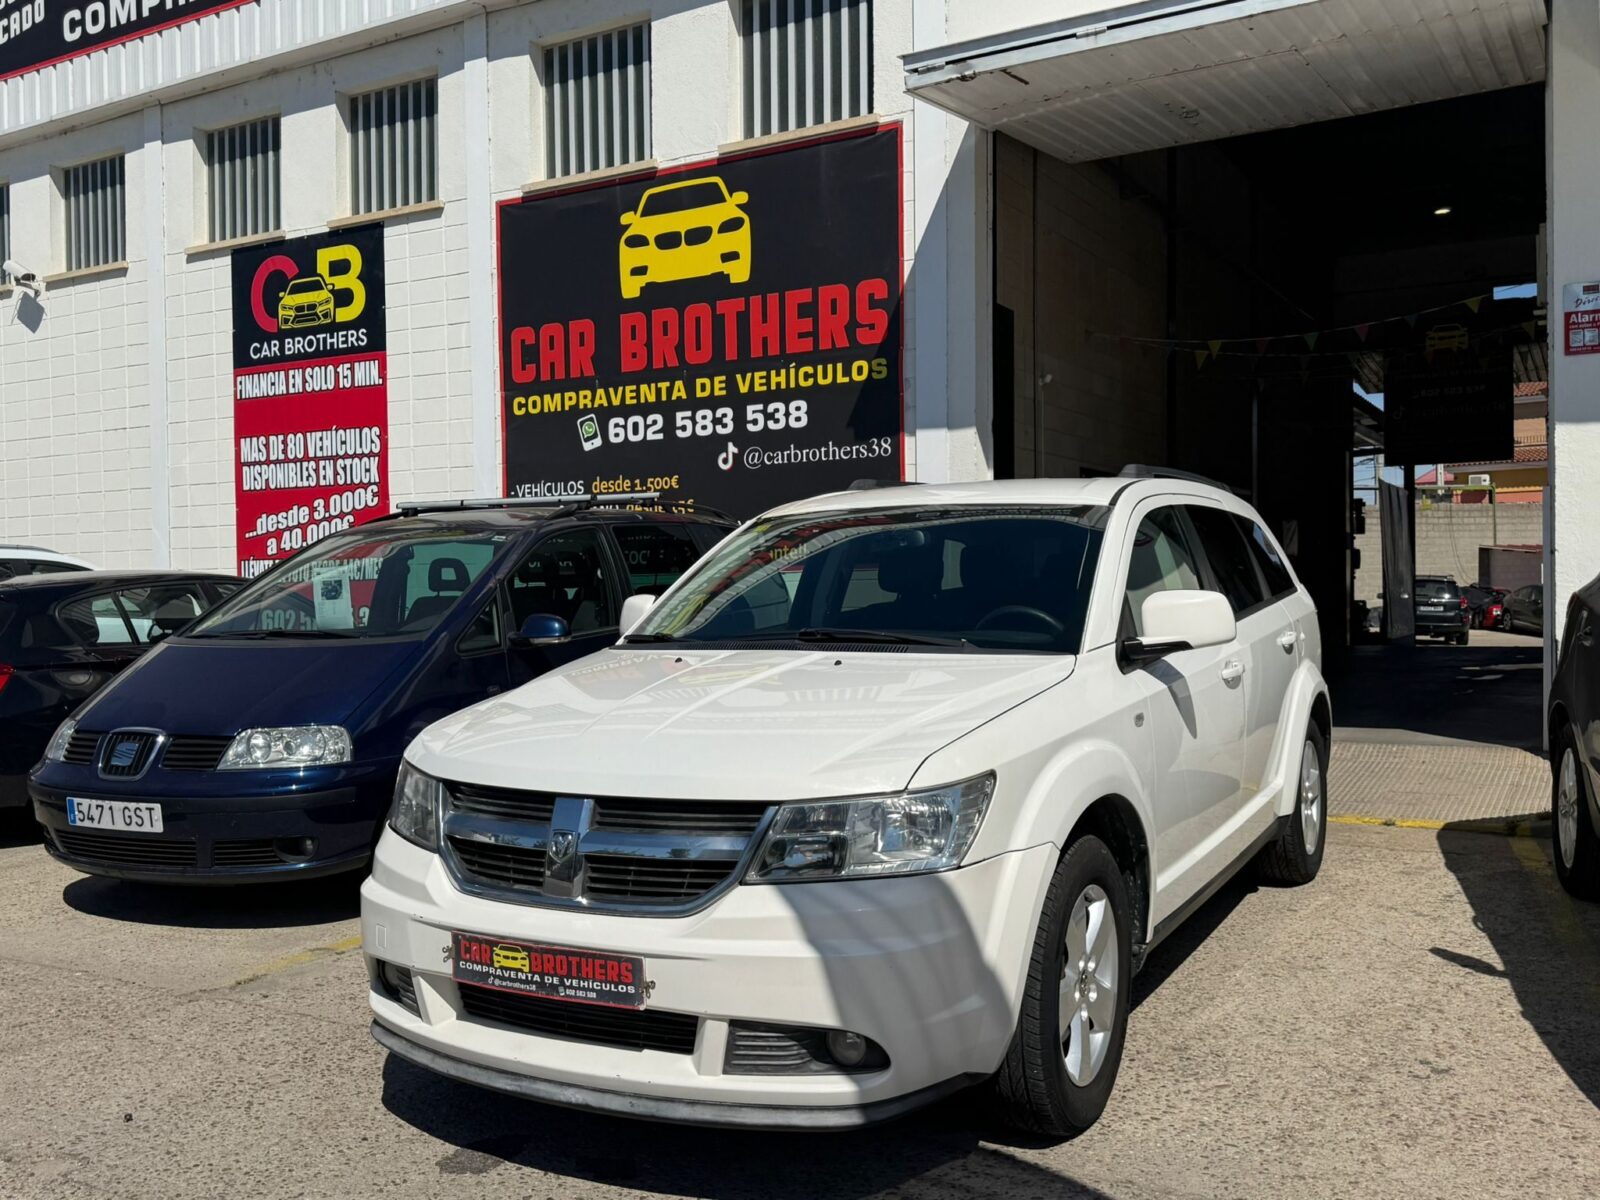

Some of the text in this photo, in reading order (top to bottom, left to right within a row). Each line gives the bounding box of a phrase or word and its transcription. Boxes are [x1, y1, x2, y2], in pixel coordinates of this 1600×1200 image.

[250, 328, 368, 359] CAR BROTHERS
[511, 278, 889, 384] CAR BROTHERS
[236, 360, 383, 400] FINANCIA EN SOLO 15 MIN.
[512, 357, 888, 417] COMPRAVENTA DE VEHÍCULOS
[608, 400, 809, 444] 602 583 538
[240, 425, 381, 463] MAS DE 80 VEHÍCULOS
[743, 436, 892, 469] @carbrothers38
[242, 457, 379, 491] DISPONIBLES EN STOCK
[591, 474, 631, 494] desde
[634, 475, 679, 494] 1.500€
[313, 484, 379, 520] 3.000€
[266, 538, 277, 556] a
[77, 802, 155, 828] 5471 GST
[459, 961, 636, 994] COMPRAVENTA DE VEHÍCULOS
[460, 938, 633, 984] CAR BROTHERS
